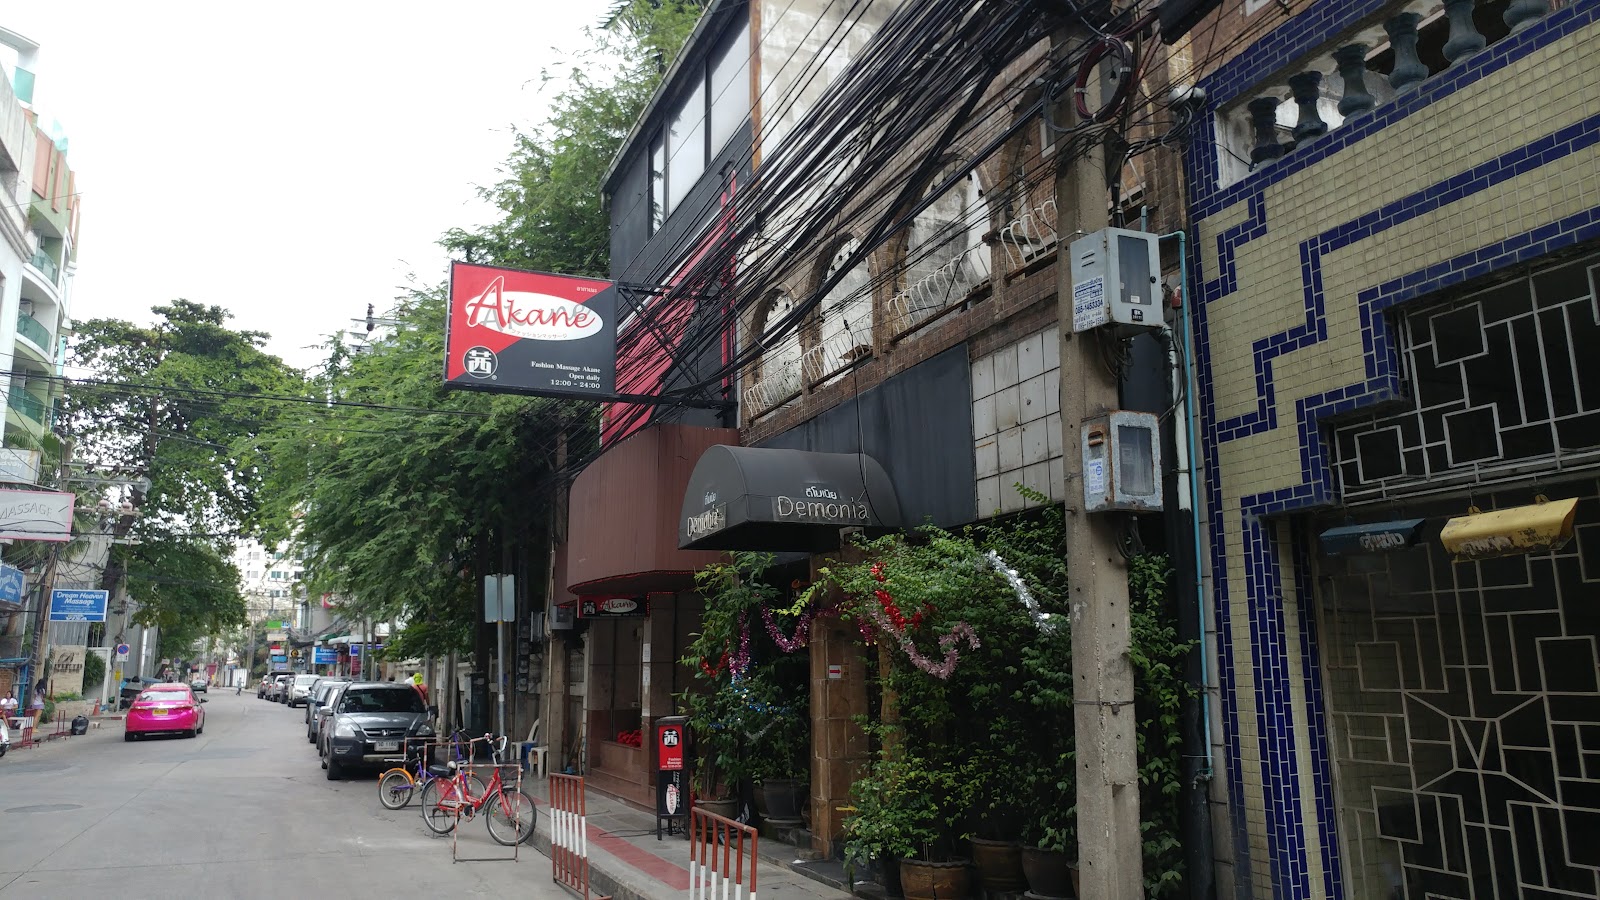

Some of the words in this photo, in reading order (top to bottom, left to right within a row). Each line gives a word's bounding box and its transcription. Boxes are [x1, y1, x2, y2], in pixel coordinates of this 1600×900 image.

[466, 276, 597, 329] Akane
[531, 361, 555, 369] Fashion
[556, 363, 581, 372] Massage
[568, 372, 585, 381] Open
[586, 374, 601, 382] daily
[551, 379, 572, 387] 12:00
[579, 381, 601, 389] 24:00
[777, 496, 870, 521] Demonia
[56, 592, 79, 600] Dream
[79, 592, 104, 600] Heaven
[64, 598, 95, 606] Massage
